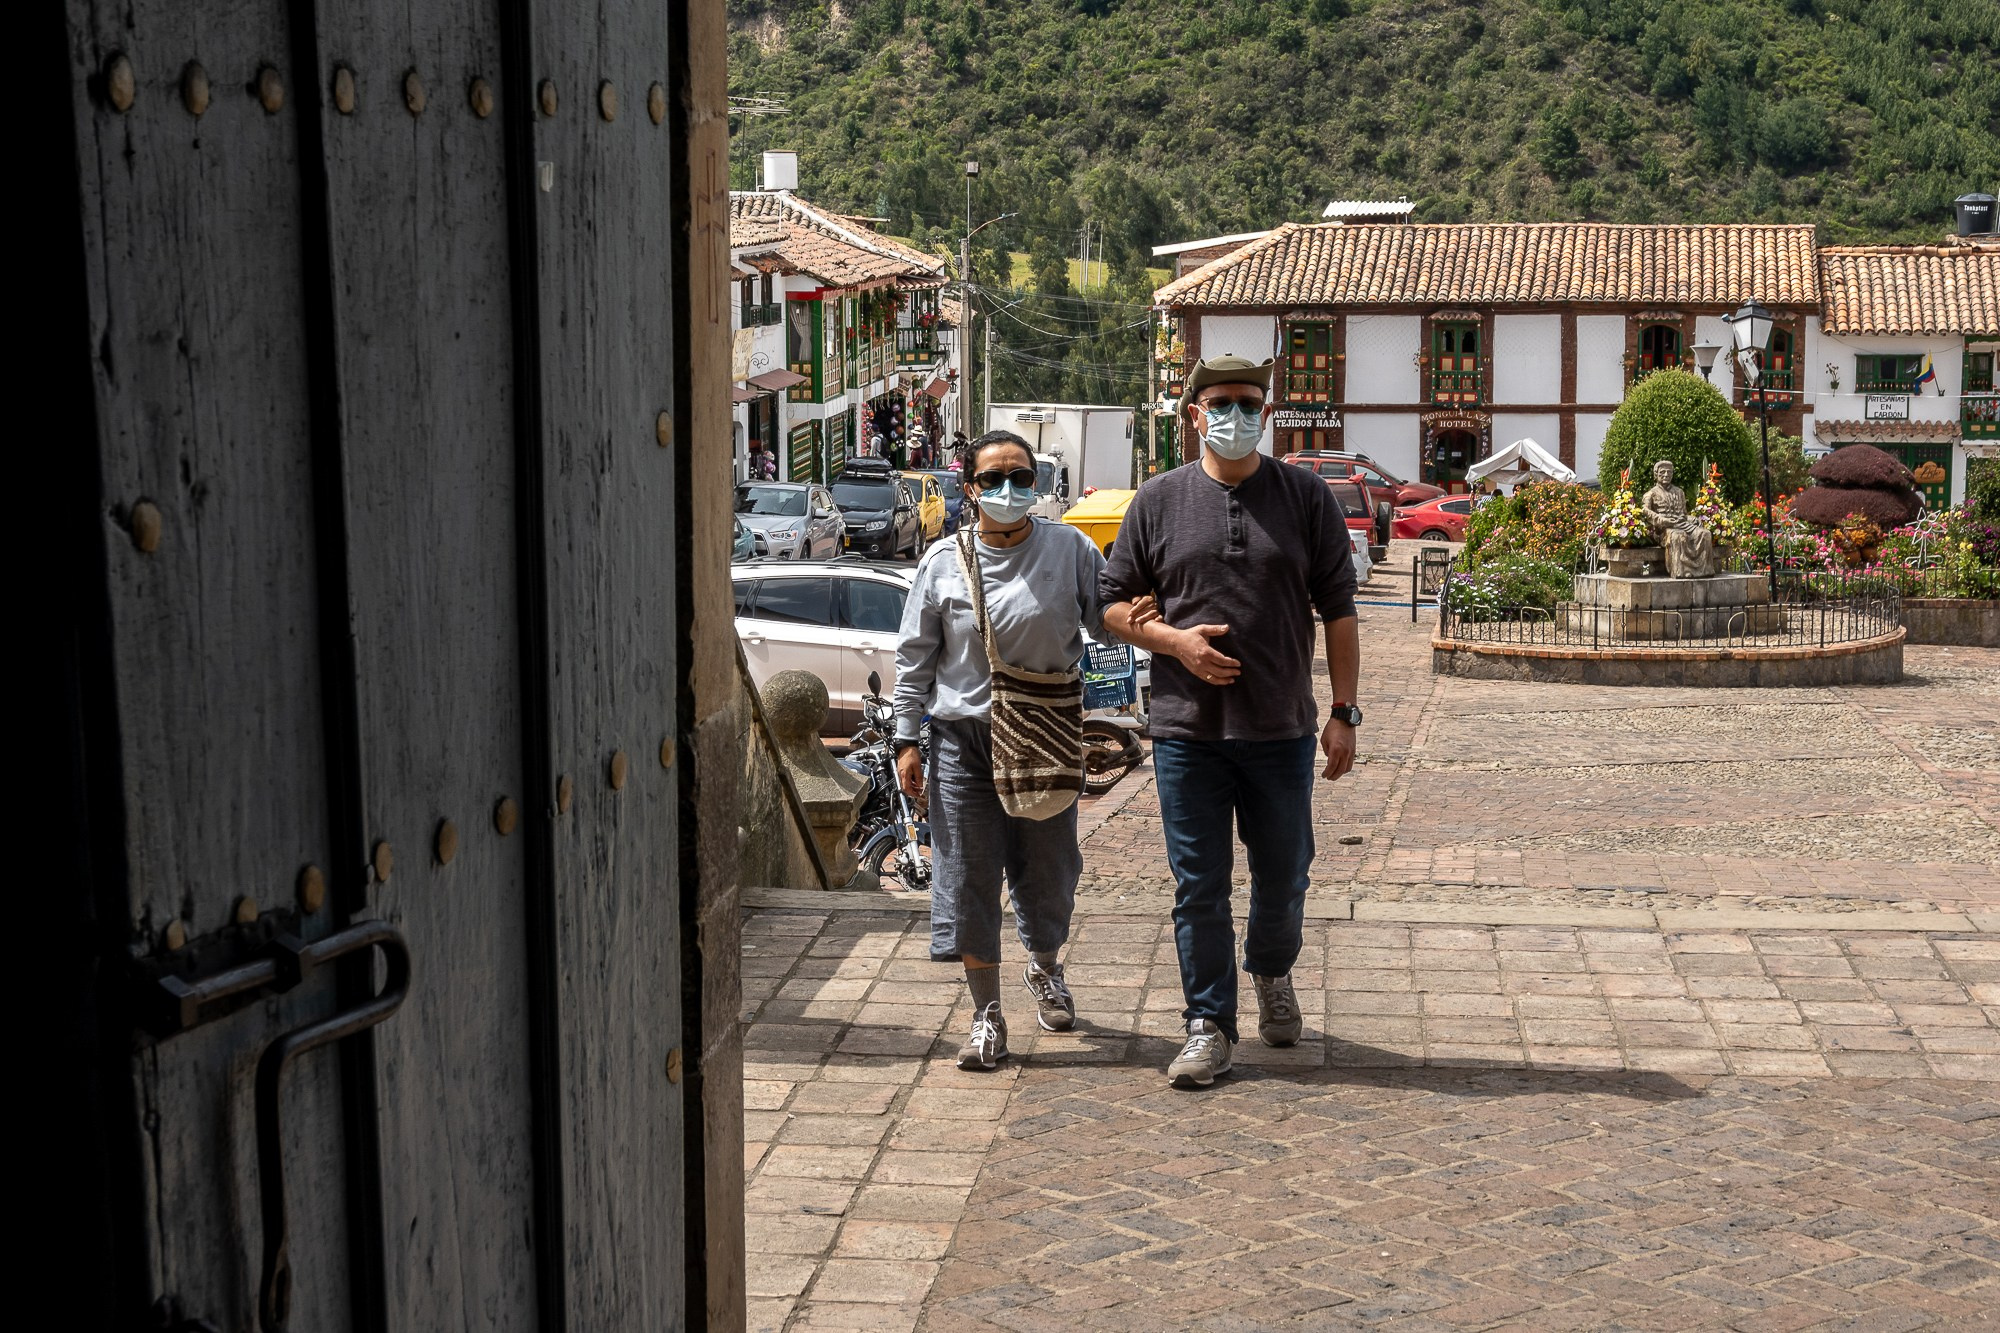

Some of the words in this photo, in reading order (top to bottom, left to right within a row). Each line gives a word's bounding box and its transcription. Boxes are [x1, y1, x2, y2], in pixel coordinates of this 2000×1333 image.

[1273, 410, 1327, 419] ARTESANIAS
[1330, 411, 1338, 419] Y
[1275, 419, 1312, 428] TEJIDOS
[1440, 420, 1474, 428] HOTEL
